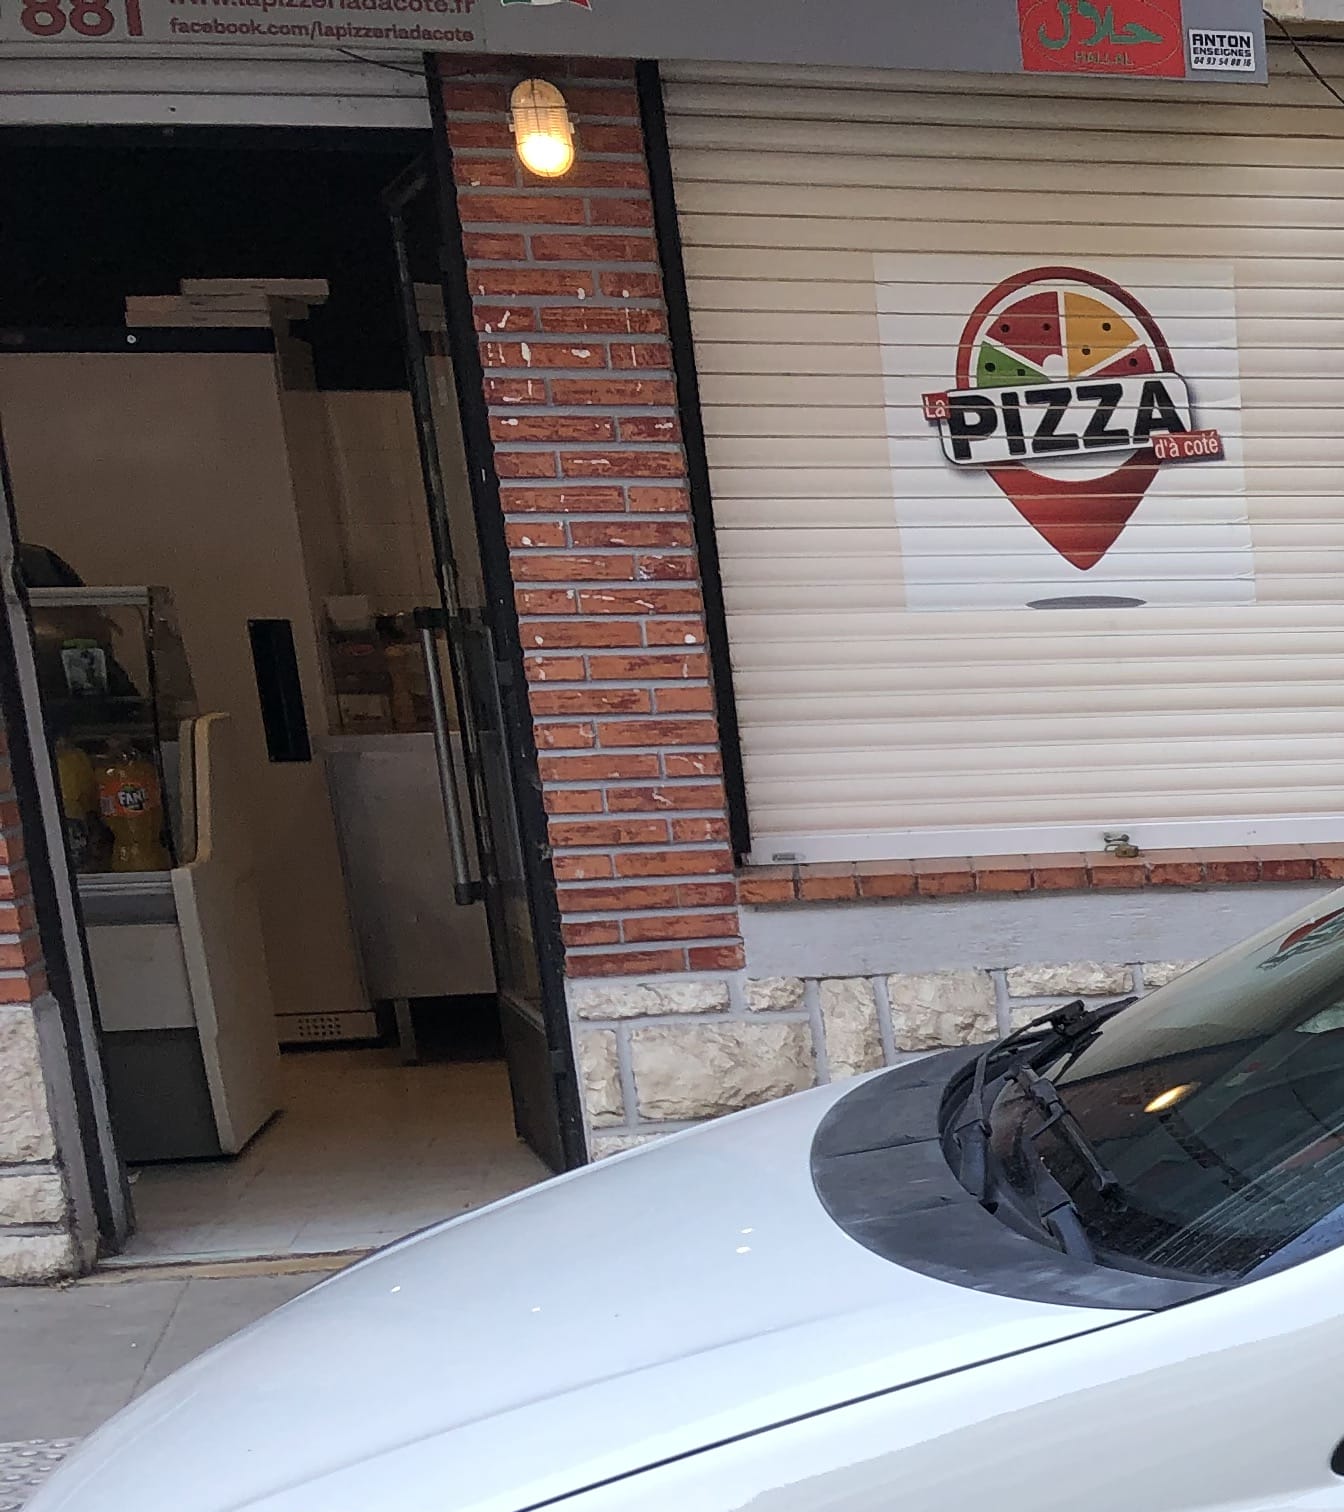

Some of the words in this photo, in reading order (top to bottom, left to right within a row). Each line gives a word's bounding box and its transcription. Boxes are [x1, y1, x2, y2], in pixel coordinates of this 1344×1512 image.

[1192, 33, 1251, 48] ANTON
[1193, 47, 1252, 57] ENSEIGNES
[925, 396, 946, 418] La
[949, 380, 1187, 460] PIZZA
[1155, 436, 1179, 458] d'à
[1184, 431, 1219, 455] coté
[117, 788, 149, 805] FANT
